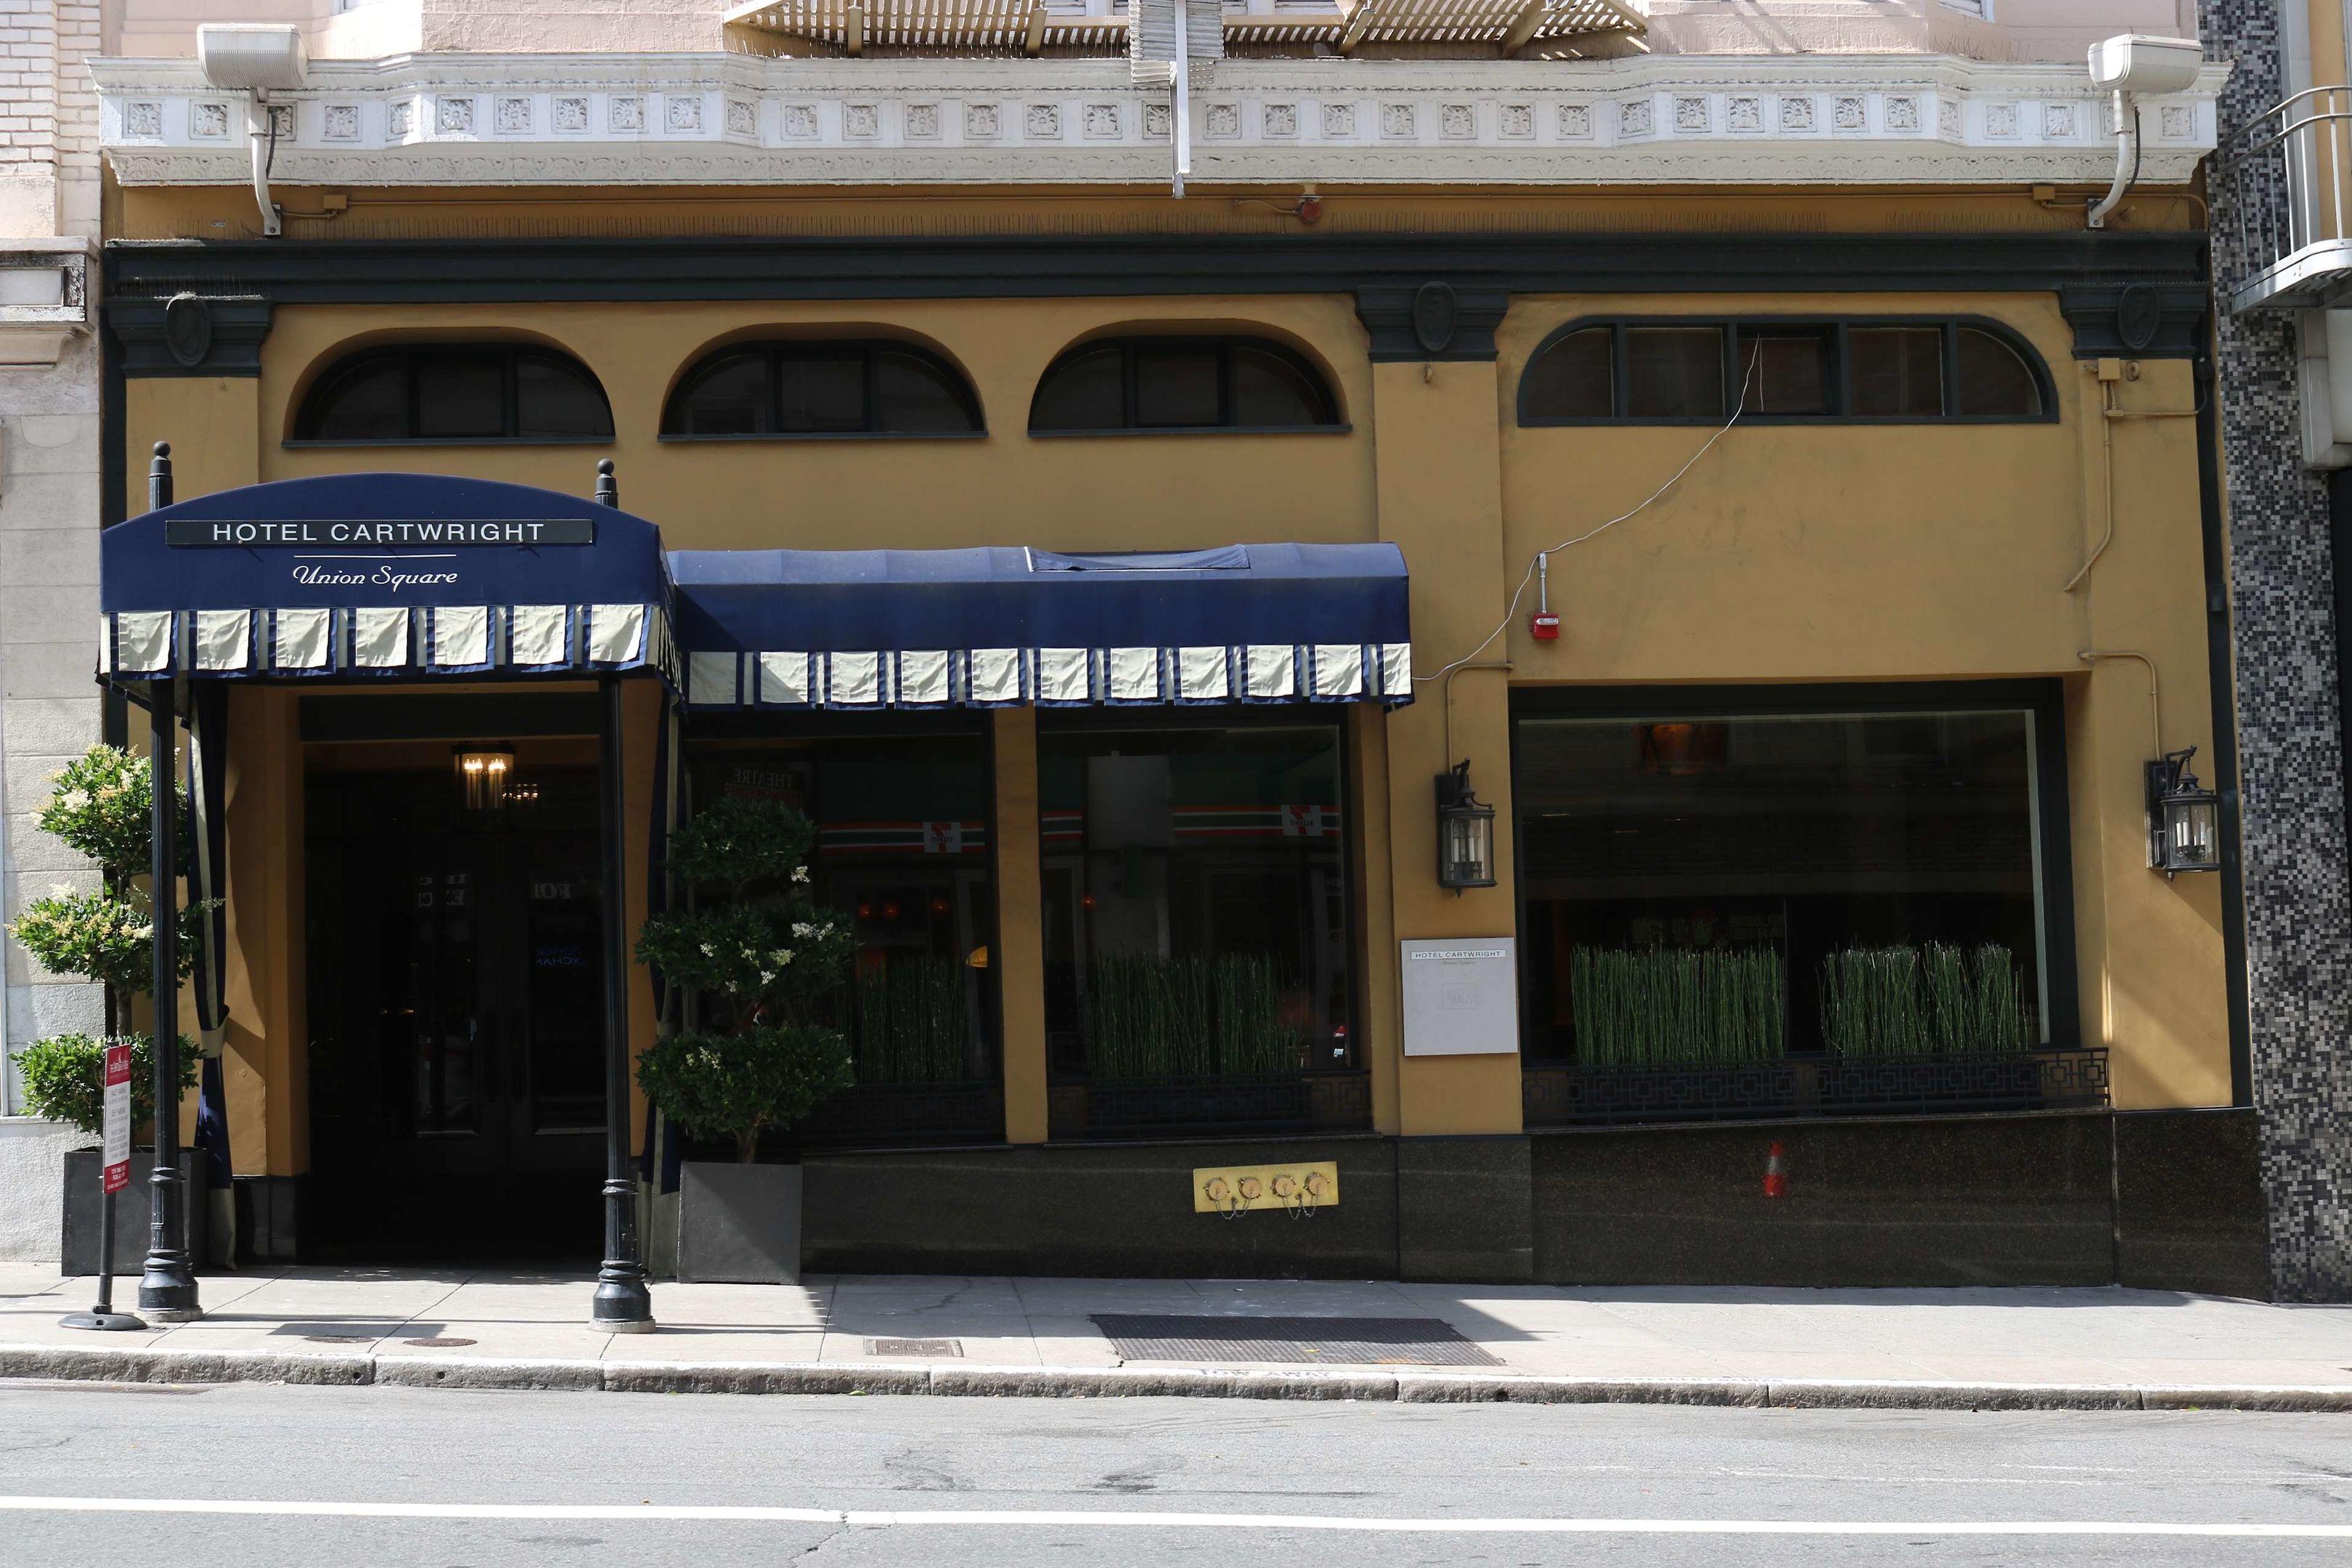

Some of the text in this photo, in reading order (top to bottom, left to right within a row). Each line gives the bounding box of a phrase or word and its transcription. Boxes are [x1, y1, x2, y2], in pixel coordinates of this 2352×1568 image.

[213, 523, 544, 541] HOTEL CARTWRIGHT
[293, 565, 458, 592] Union Square
